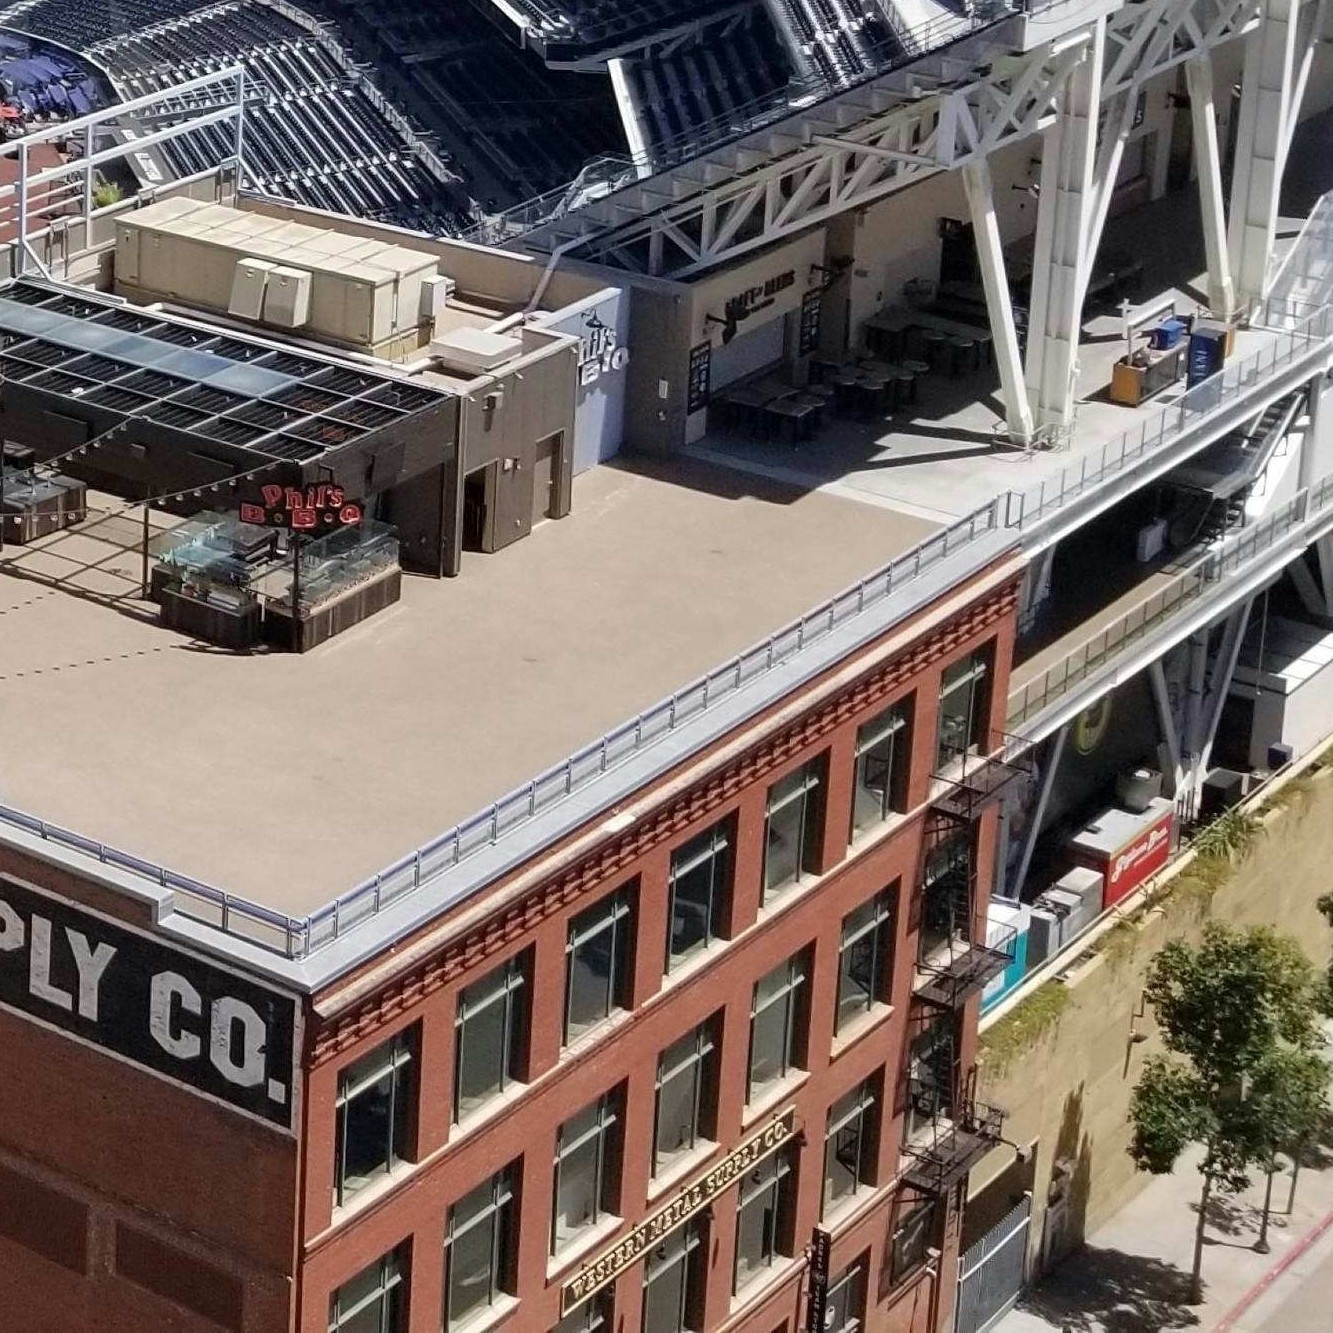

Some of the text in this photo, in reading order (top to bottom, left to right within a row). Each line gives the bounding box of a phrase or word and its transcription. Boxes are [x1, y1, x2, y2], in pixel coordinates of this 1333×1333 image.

[261, 484, 345, 510] Phil's
[149, 970, 286, 1105] CO.
[570, 1120, 789, 1299] WESTERN METAL SUPPLY CO.
